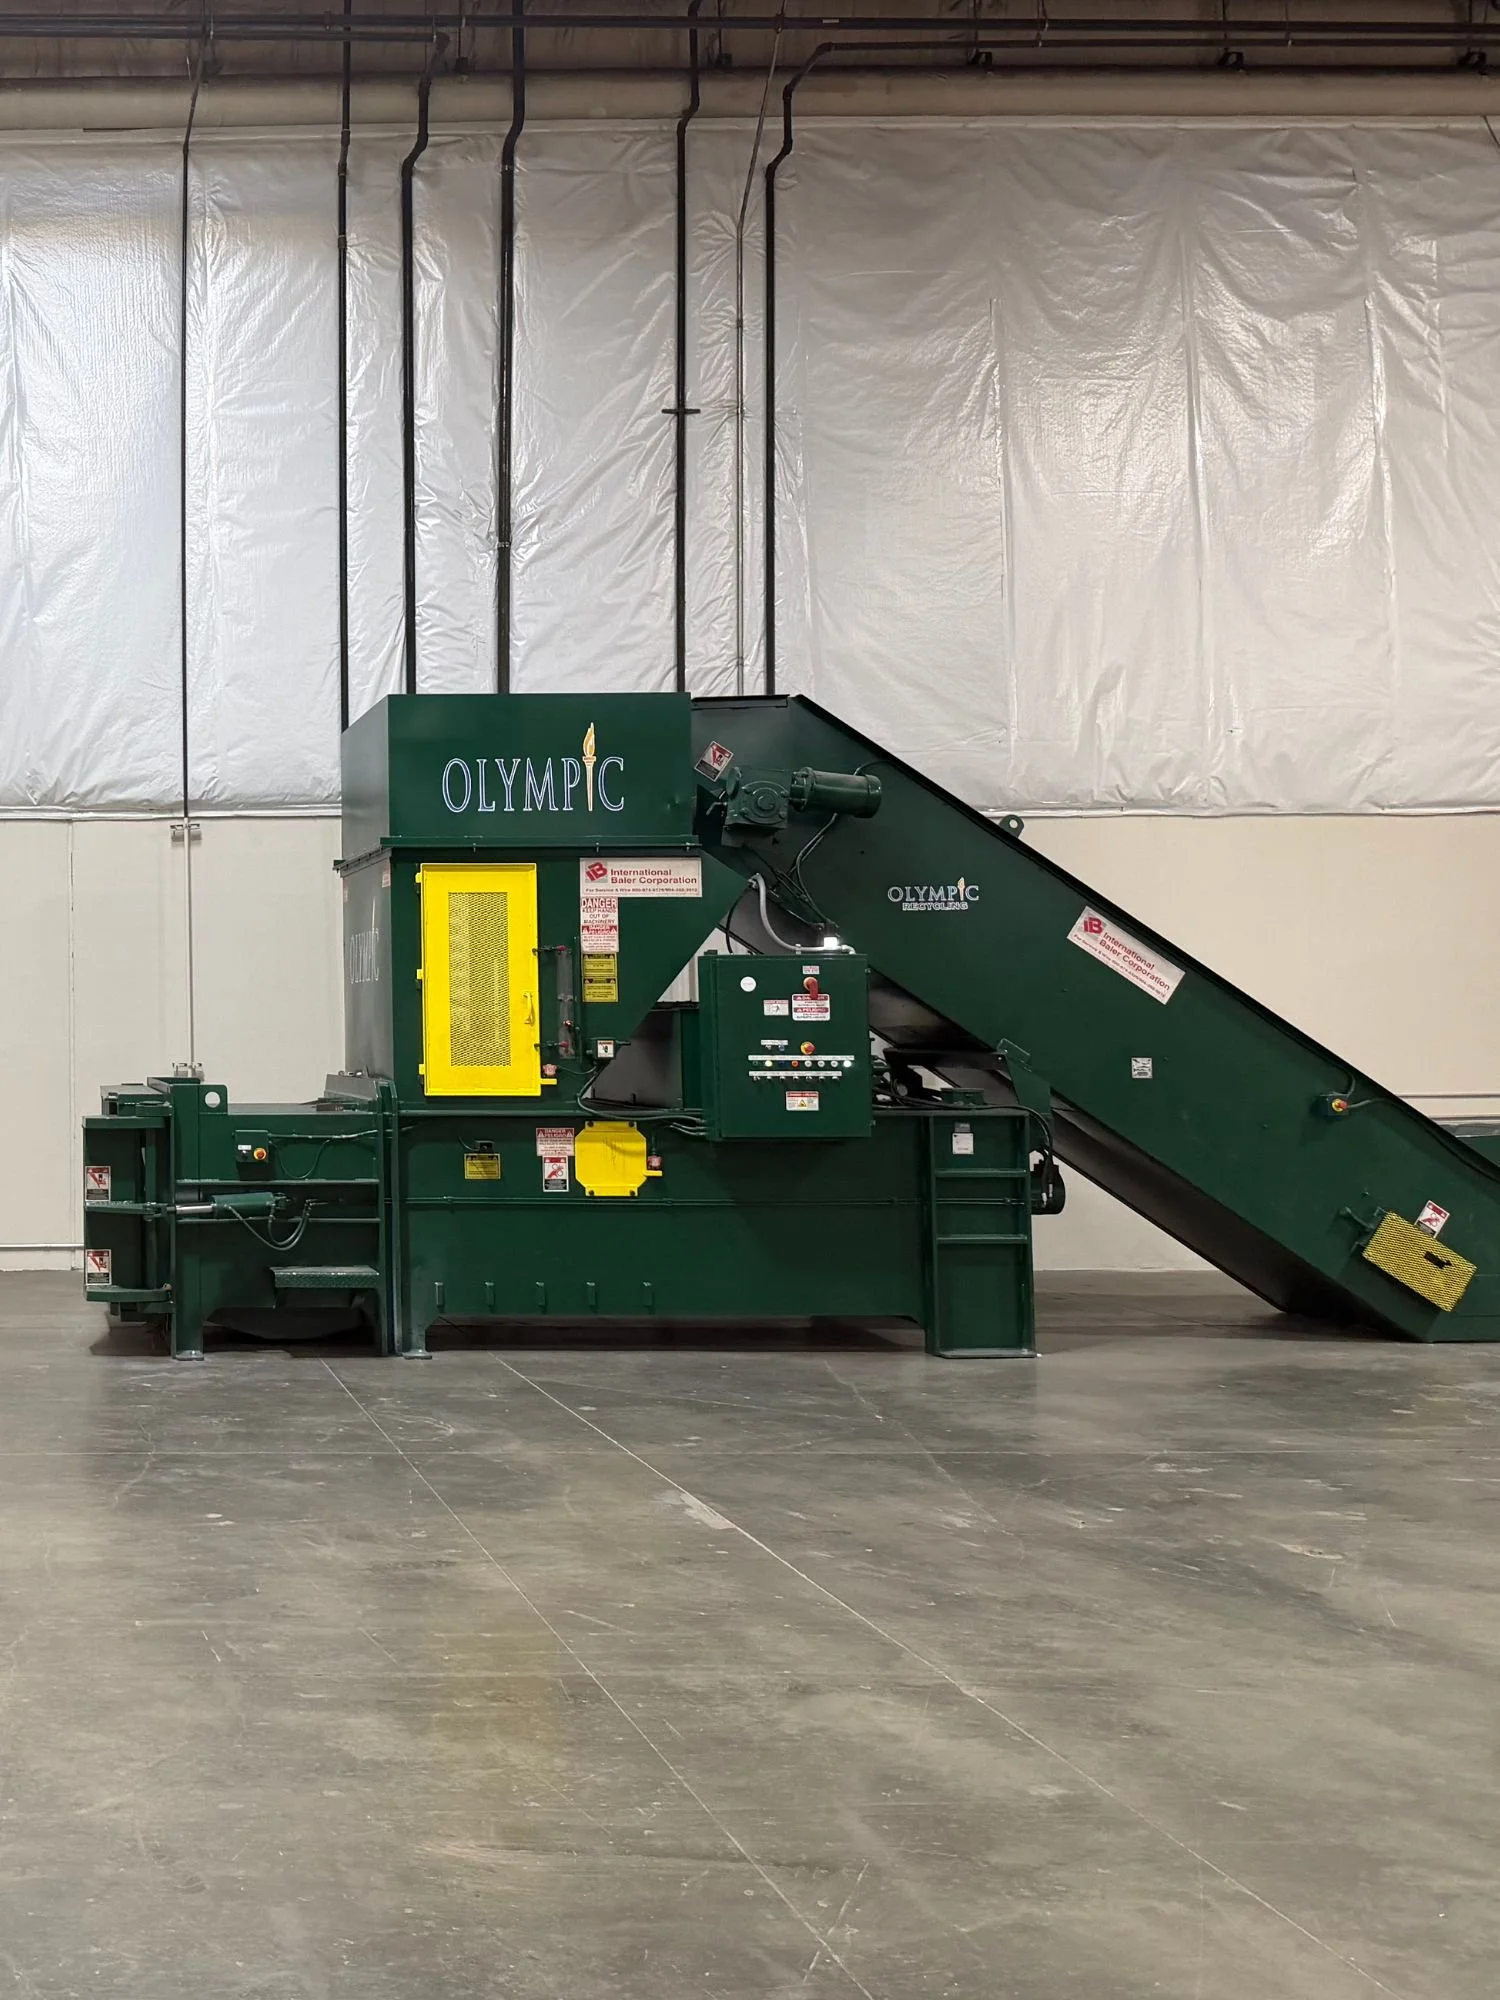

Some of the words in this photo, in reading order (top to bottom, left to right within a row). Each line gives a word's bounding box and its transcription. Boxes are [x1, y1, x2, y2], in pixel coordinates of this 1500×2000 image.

[441, 722, 625, 813] OLYMPIC
[611, 868, 672, 876] International
[611, 876, 636, 884] Baler
[639, 876, 697, 886] Corporation
[887, 877, 980, 903] OLYMPIC
[582, 898, 617, 908] DANGER
[902, 902, 969, 911] RECYCLING
[1103, 932, 1155, 970] International
[1099, 939, 1121, 957] Baler
[1122, 955, 1170, 991] Corporation
